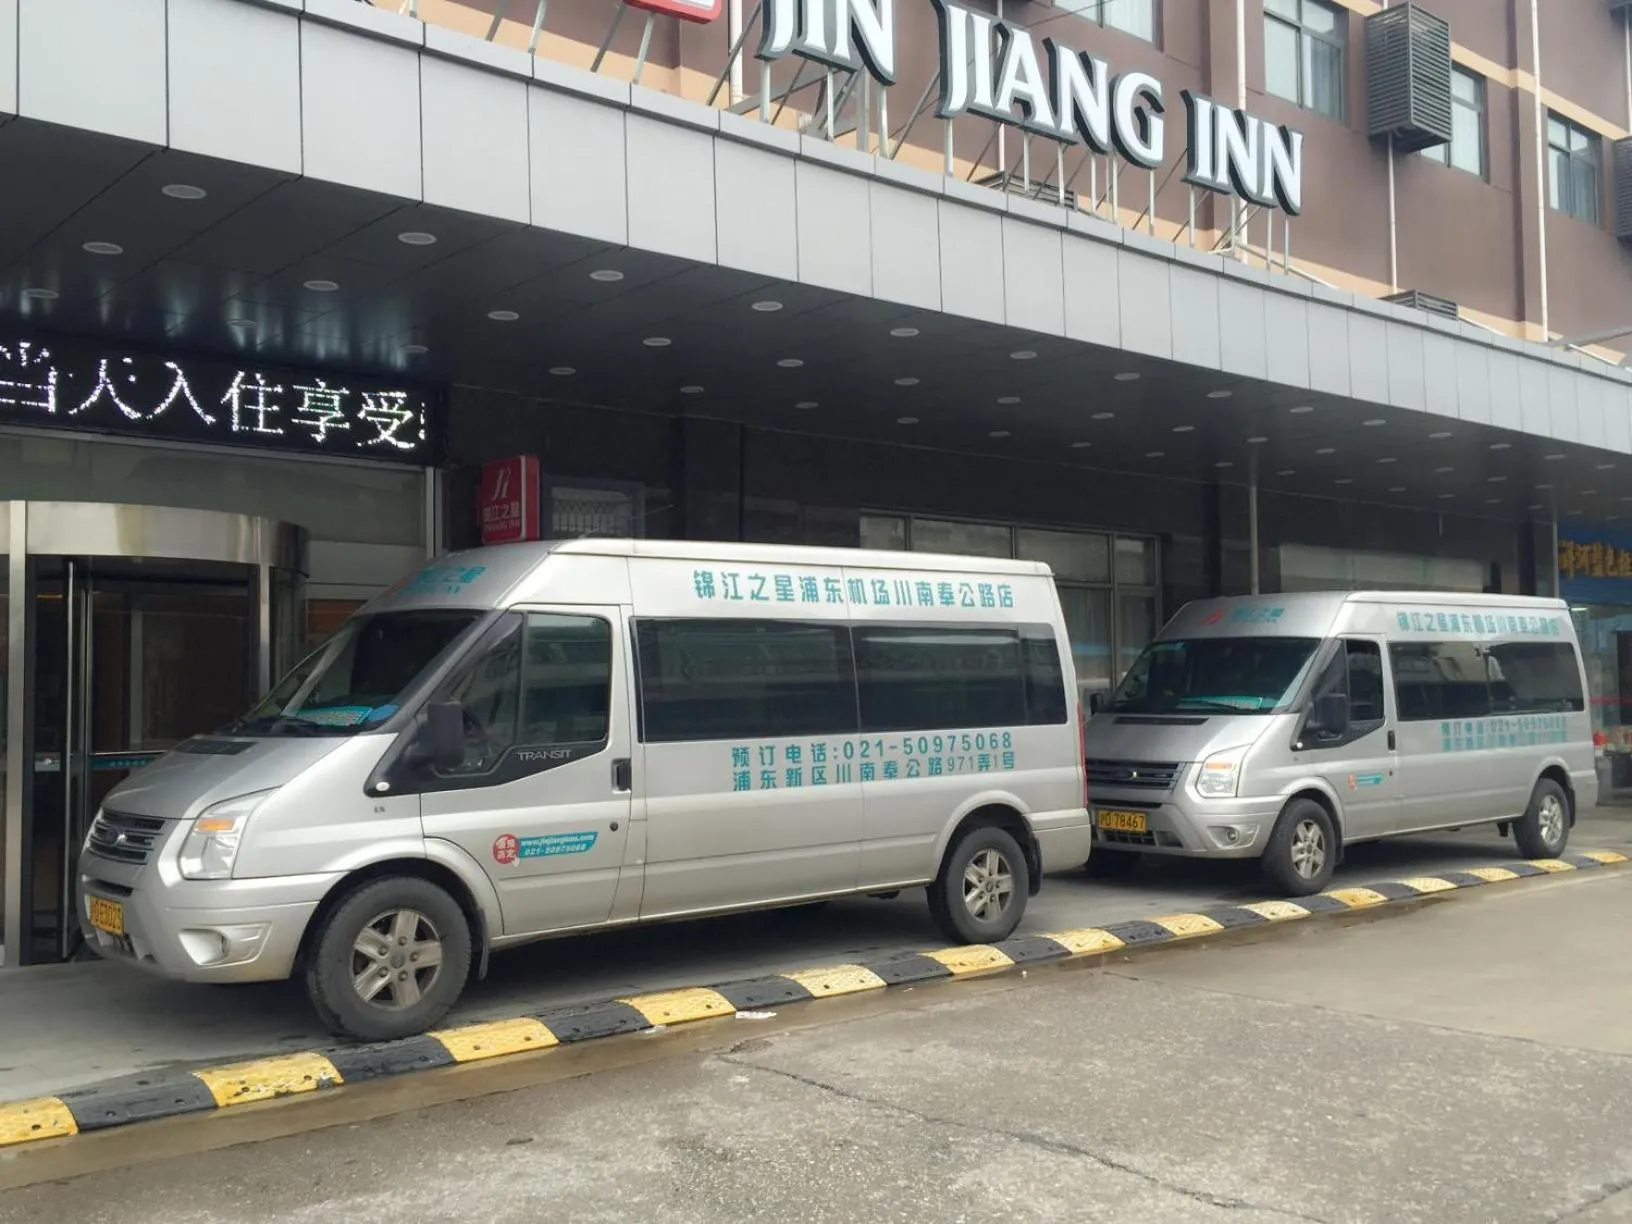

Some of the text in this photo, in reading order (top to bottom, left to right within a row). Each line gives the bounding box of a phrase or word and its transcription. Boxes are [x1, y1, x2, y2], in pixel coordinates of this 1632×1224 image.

[937, 2, 1165, 168] JIANG
[1180, 89, 1301, 215] INN
[693, 569, 1014, 608] 锦江之星浦东机场川南奉公路店
[518, 750, 572, 761] TRANSIT
